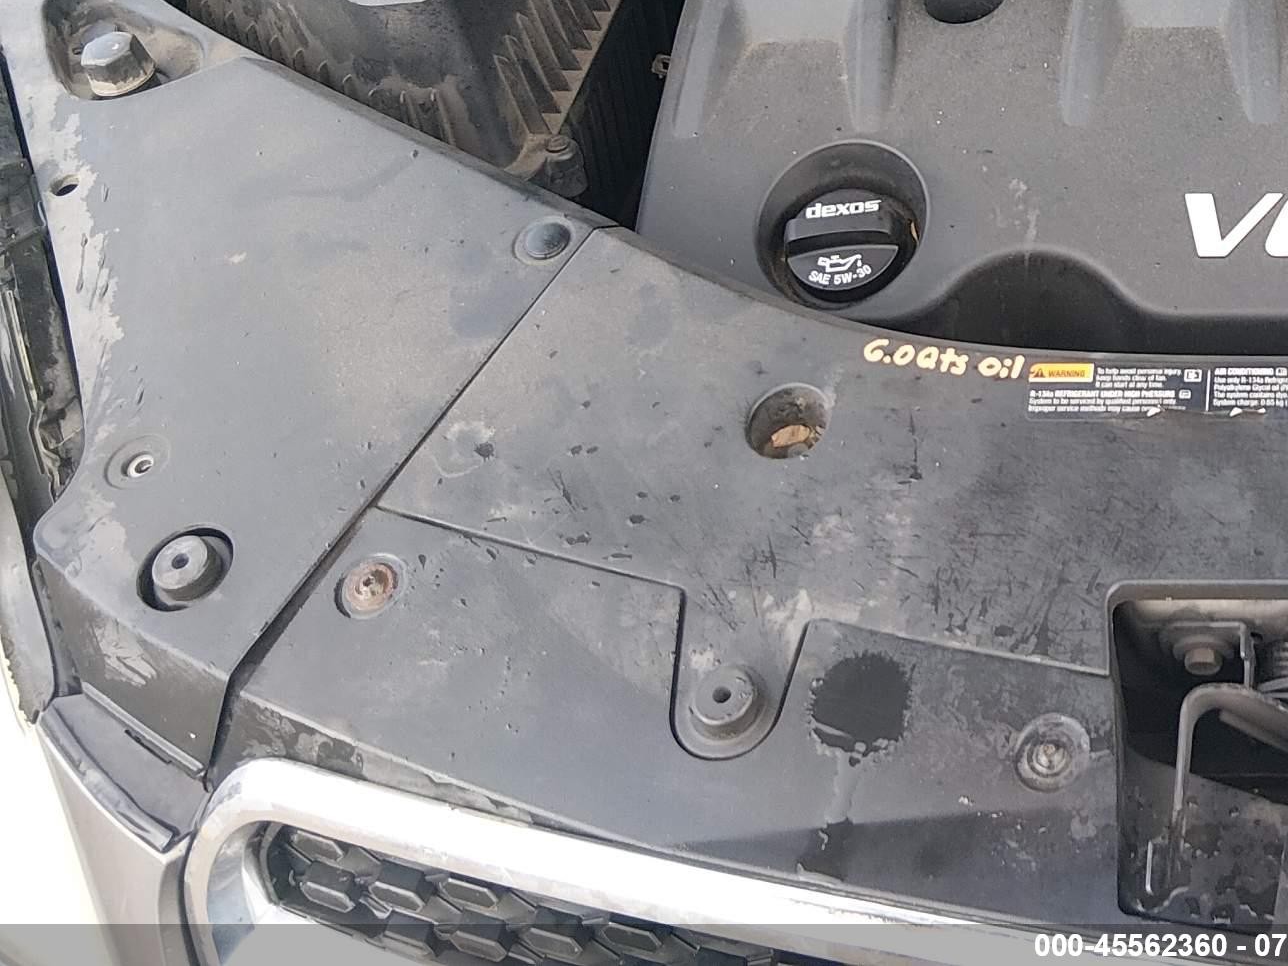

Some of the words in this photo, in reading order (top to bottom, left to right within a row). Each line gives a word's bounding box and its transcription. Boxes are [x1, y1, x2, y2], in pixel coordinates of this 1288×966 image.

[805, 199, 881, 218] dexos
[808, 270, 831, 285] SAE
[833, 264, 872, 285] 5W-30
[977, 354, 1025, 379] Oil
[1048, 370, 1086, 378] WARNING
